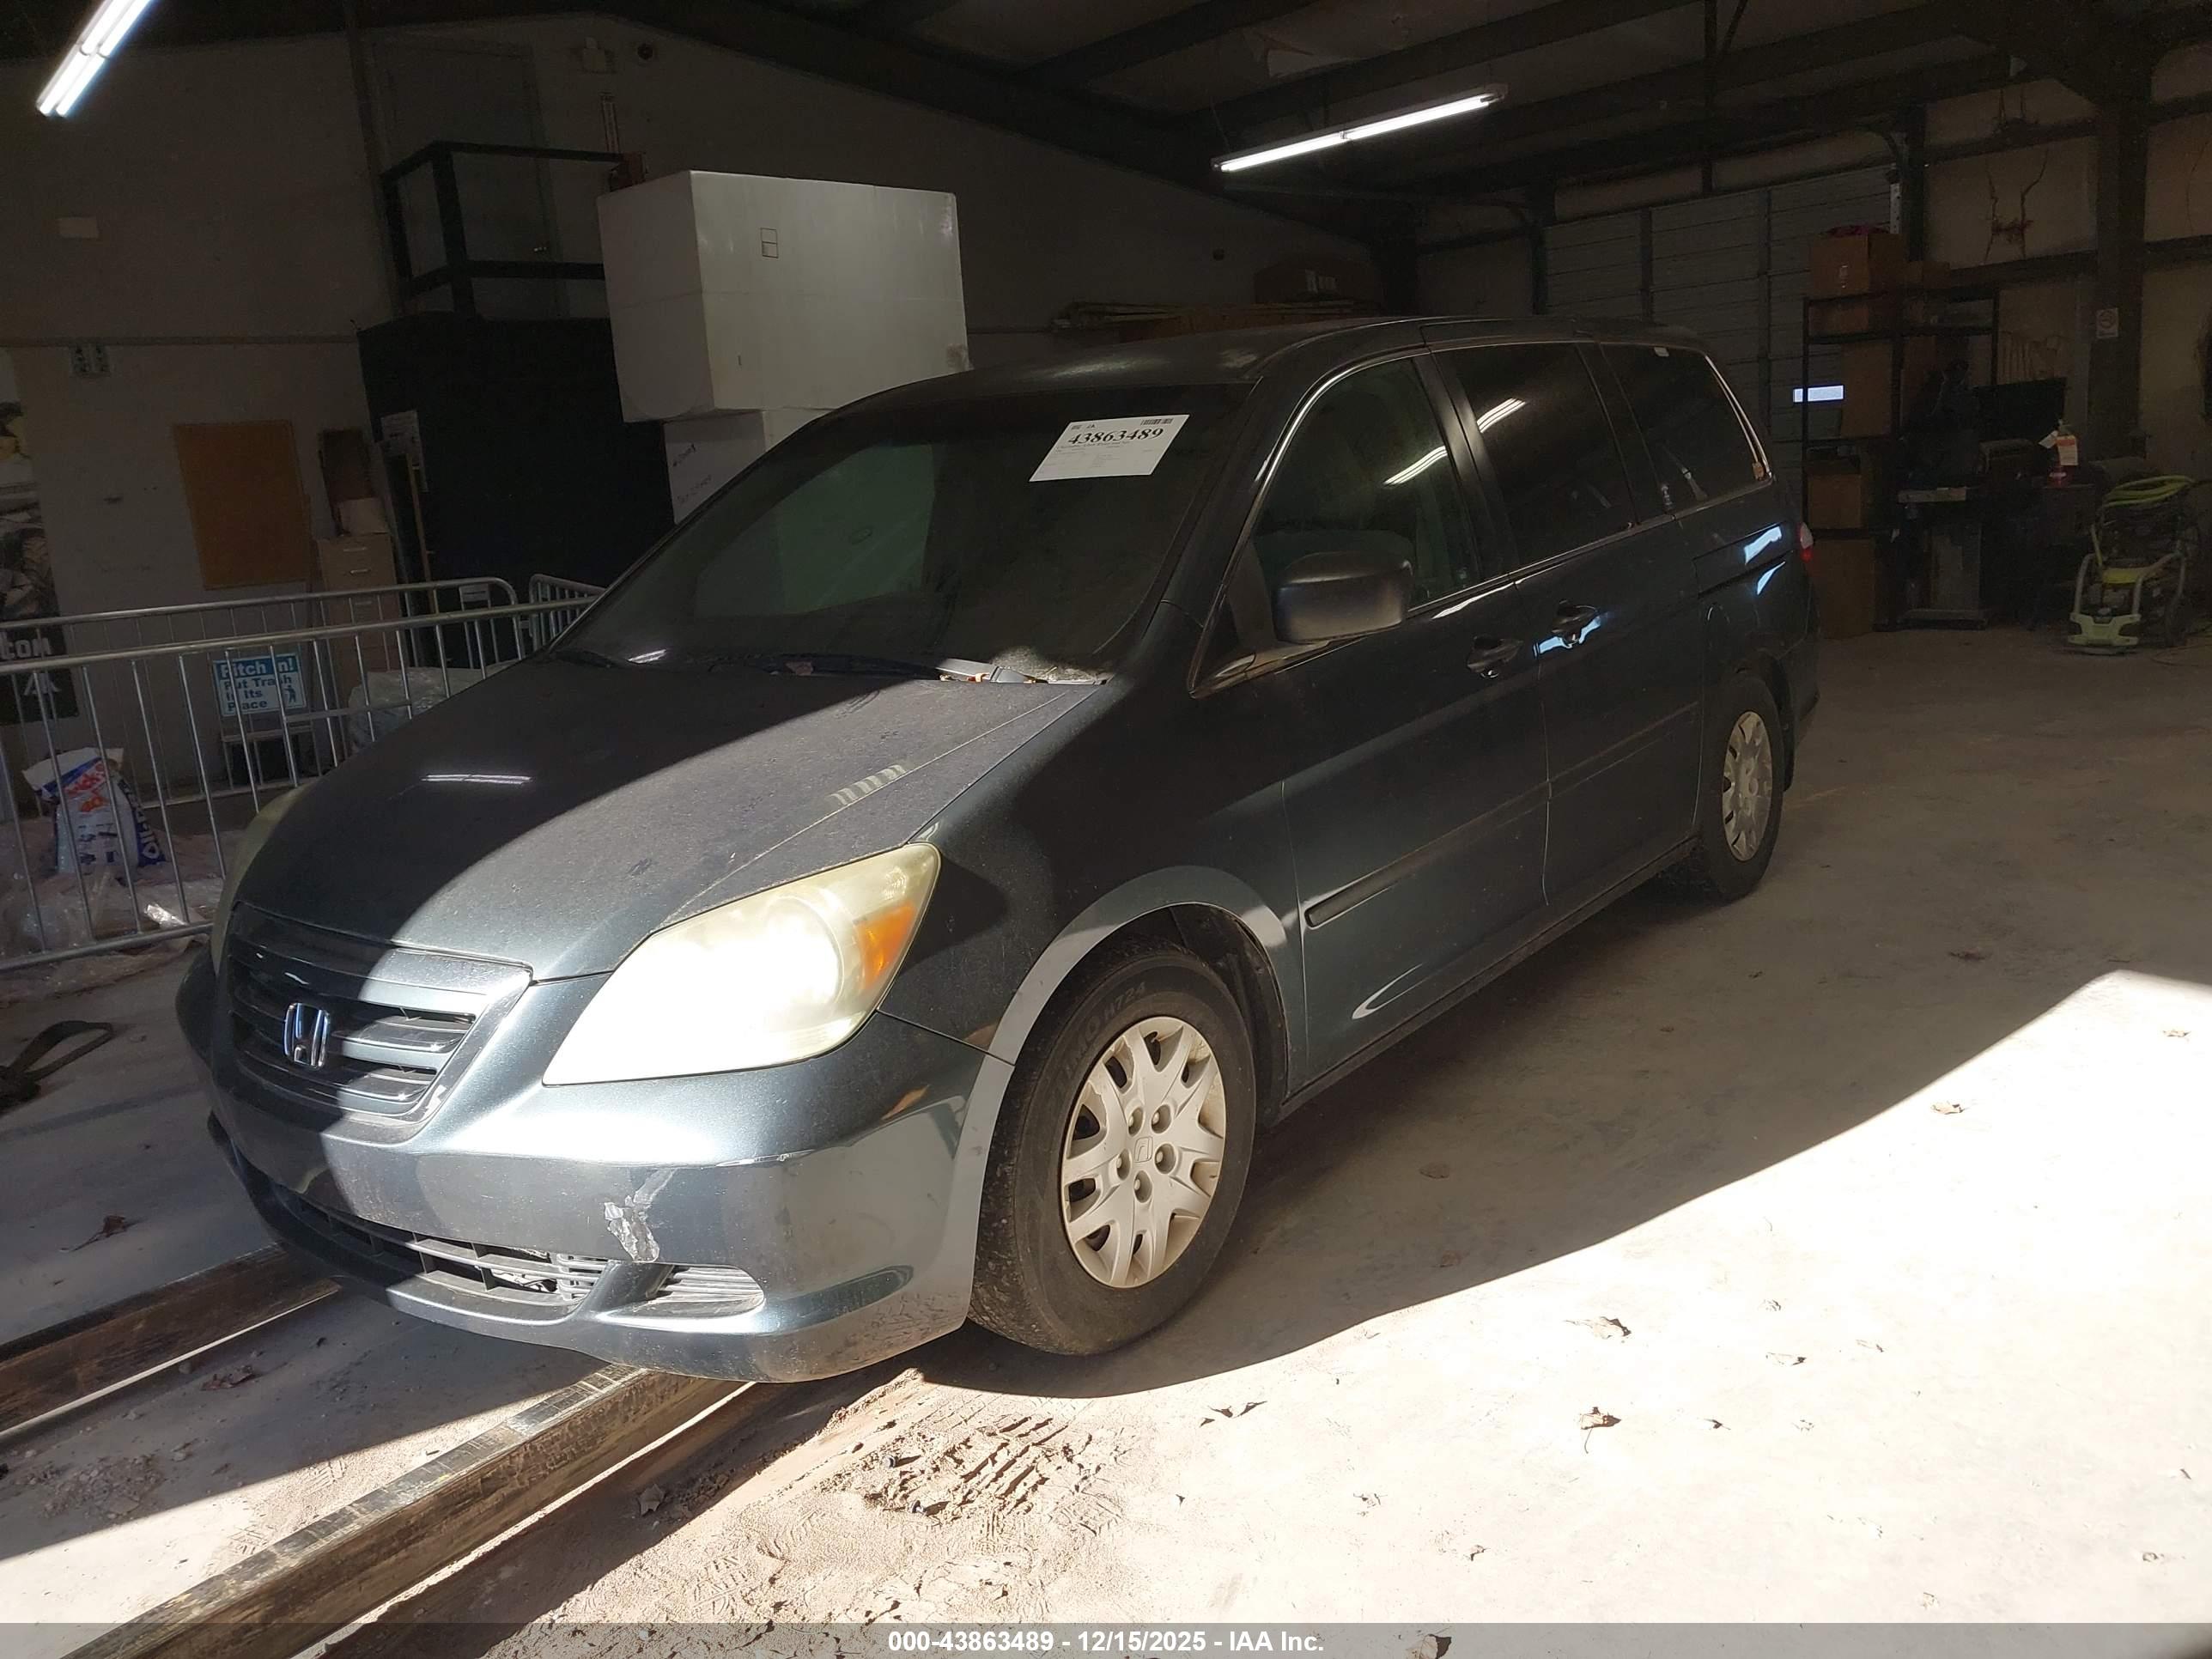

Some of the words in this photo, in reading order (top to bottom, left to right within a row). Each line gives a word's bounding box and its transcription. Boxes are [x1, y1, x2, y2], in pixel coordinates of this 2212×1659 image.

[1067, 428, 1164, 445] 43863489
[220, 660, 267, 679] Pitch
[272, 655, 295, 674] n!
[244, 689, 264, 699] Its
[227, 700, 268, 712] Pace
